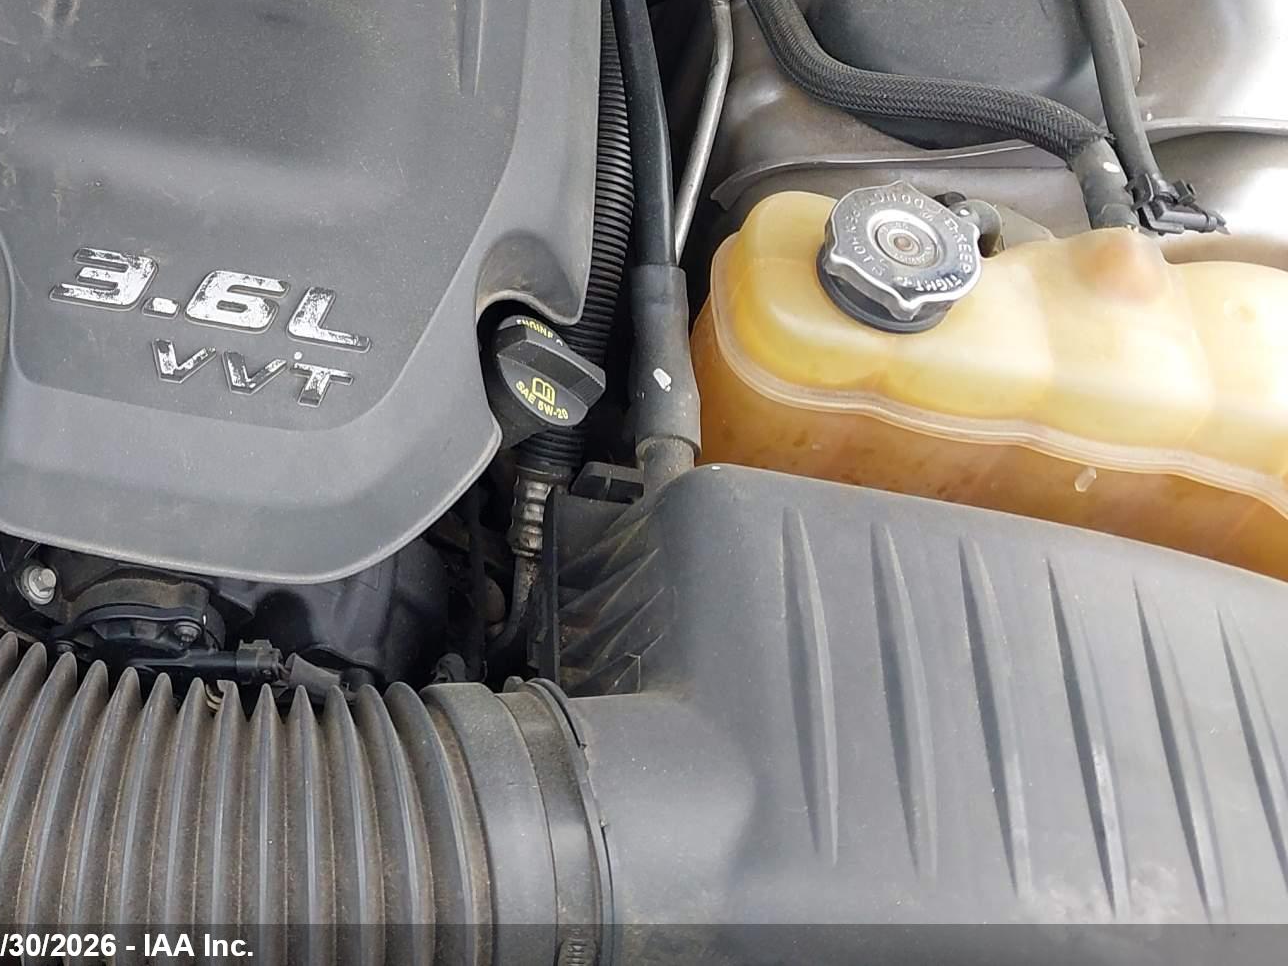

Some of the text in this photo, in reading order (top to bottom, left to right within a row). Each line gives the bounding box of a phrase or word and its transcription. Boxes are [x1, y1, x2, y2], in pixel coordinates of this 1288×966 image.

[49, 247, 372, 353] 3.6L
[915, 274, 963, 292] TIGHT
[151, 338, 354, 407] VVT
[515, 380, 569, 420] SAE 5W-20
